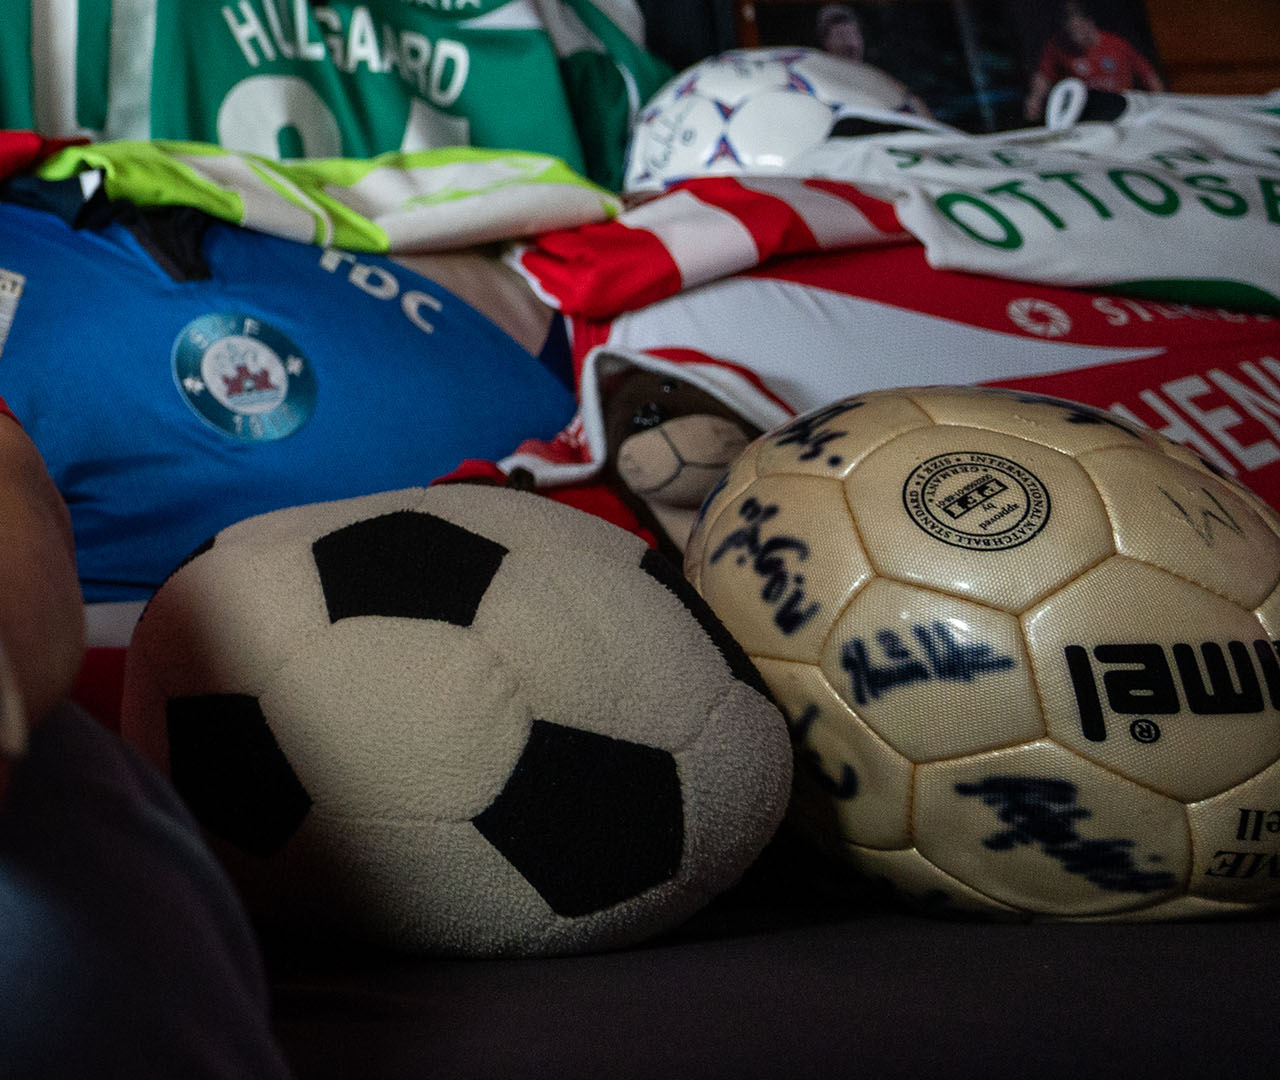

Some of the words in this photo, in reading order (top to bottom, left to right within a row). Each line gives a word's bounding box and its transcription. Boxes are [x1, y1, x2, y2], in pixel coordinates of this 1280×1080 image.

[925, 465, 980, 496] GERMANY
[908, 489, 953, 539] STANDARD
[977, 502, 1020, 531] approved
[981, 500, 998, 513] by
[953, 519, 1035, 548] MATCHBALL
